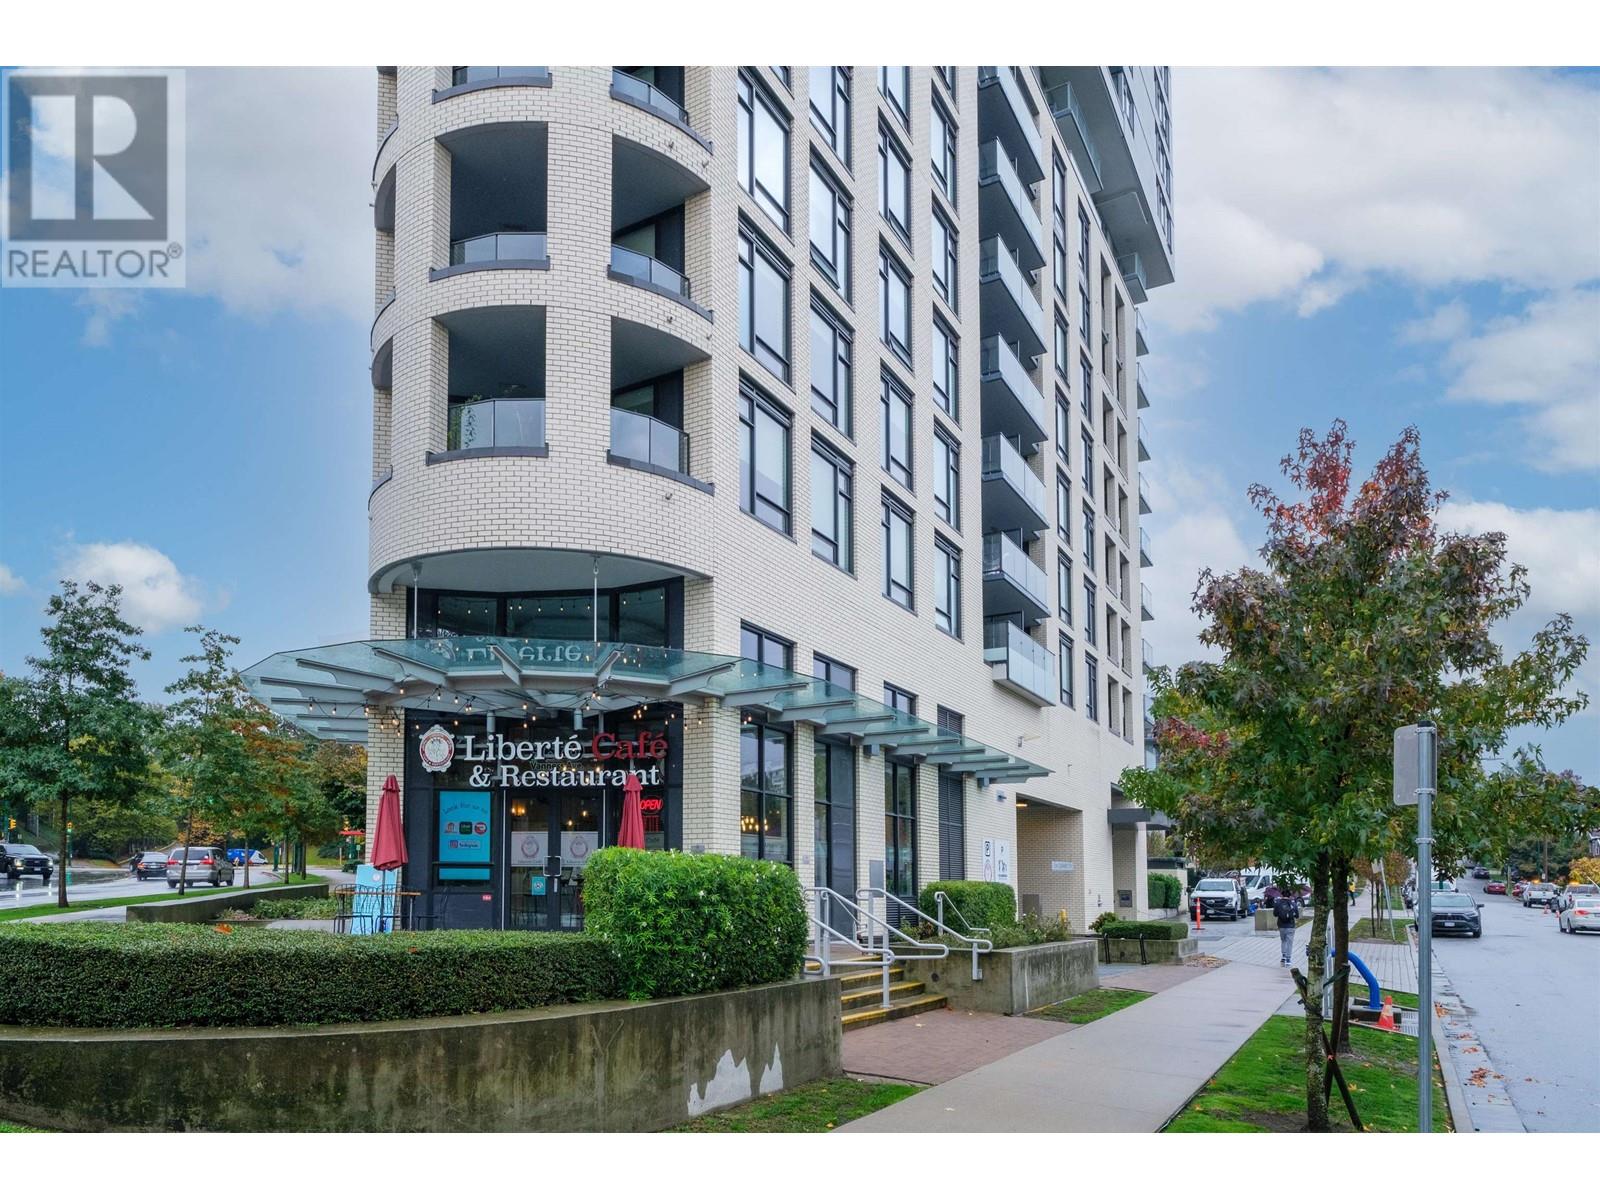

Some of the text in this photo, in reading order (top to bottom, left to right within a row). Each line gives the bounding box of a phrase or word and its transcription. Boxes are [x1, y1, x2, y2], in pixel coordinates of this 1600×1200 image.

[463, 734, 582, 761] Liberté
[592, 732, 669, 760] Café
[469, 765, 660, 787] & Restaurant
[640, 799, 662, 810] OPEN
